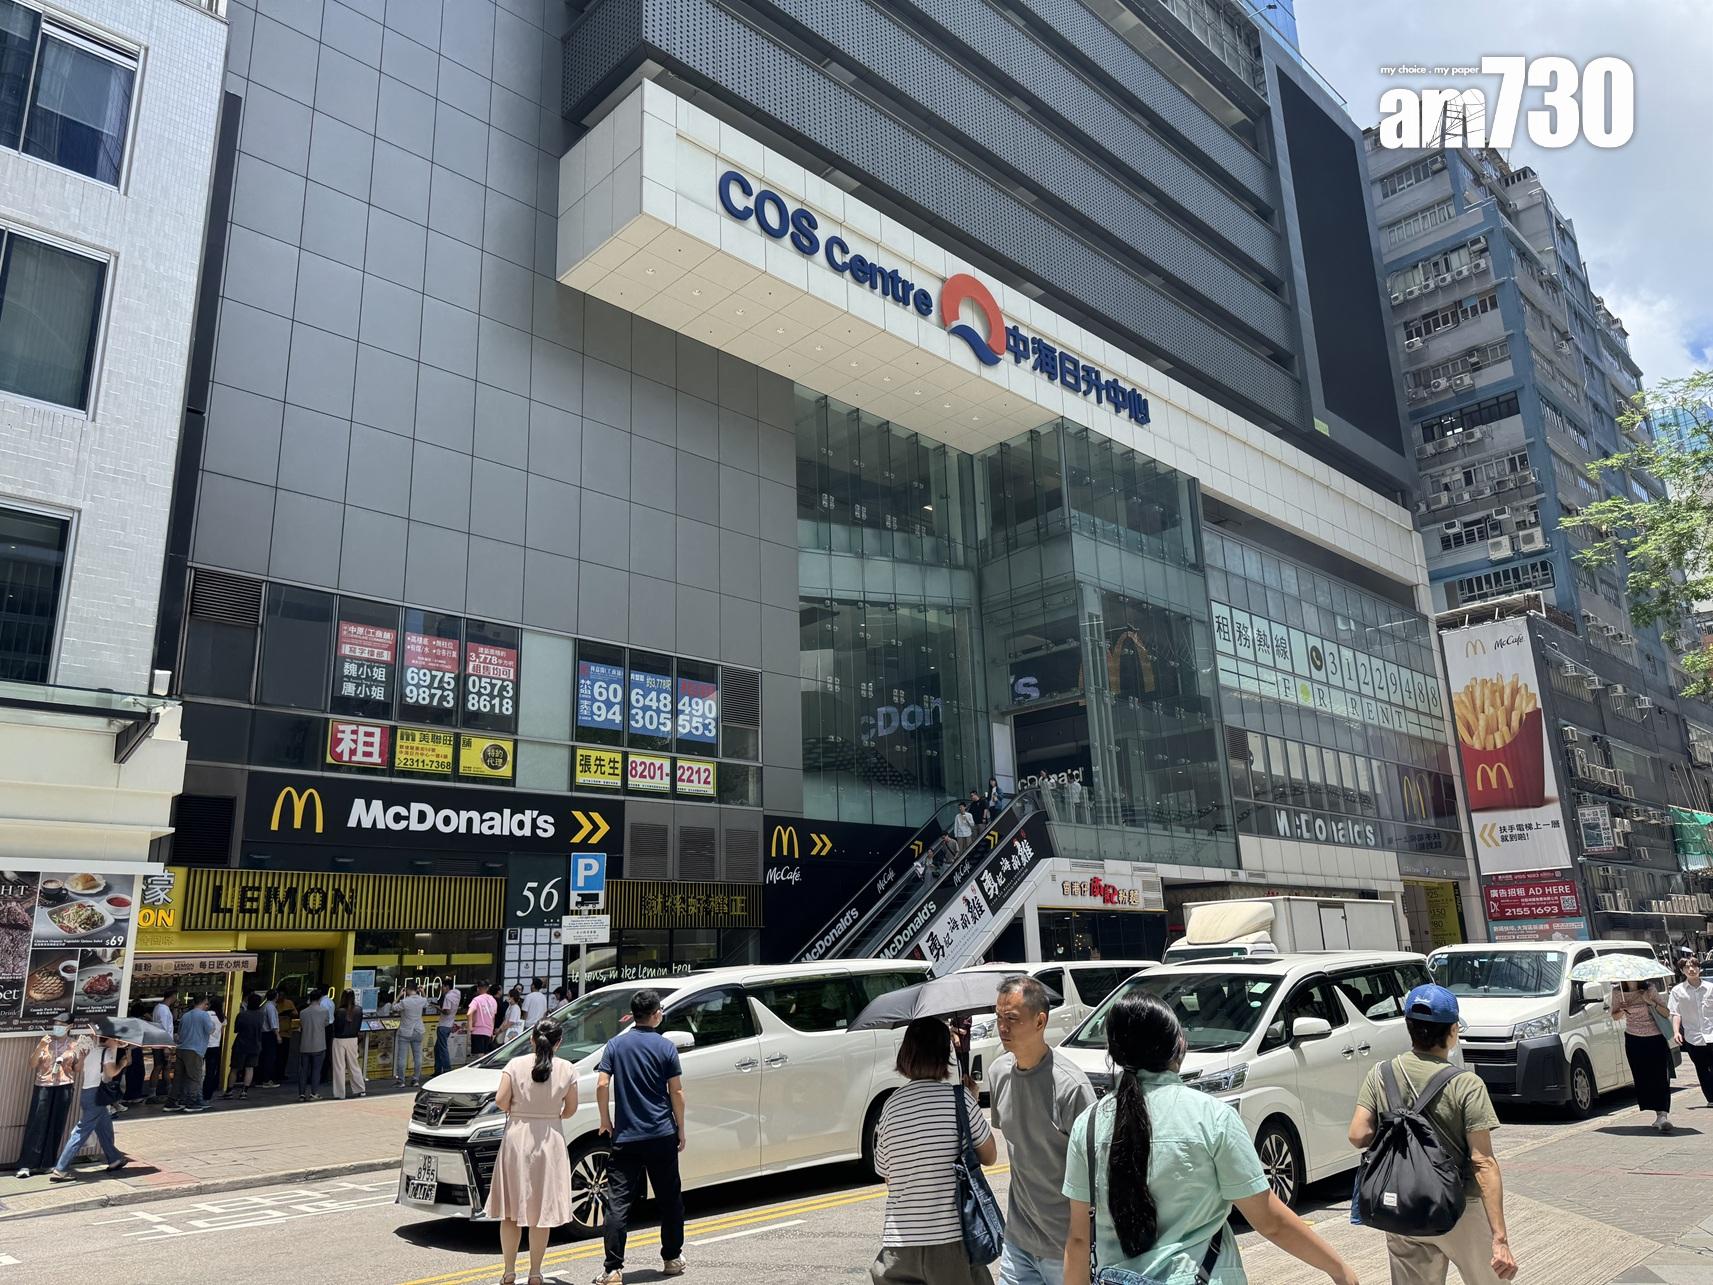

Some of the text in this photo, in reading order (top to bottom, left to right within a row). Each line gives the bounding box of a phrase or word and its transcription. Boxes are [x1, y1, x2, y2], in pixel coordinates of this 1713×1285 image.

[719, 170, 934, 317] COS Centre
[1005, 325, 1151, 426] 中海日升中心
[1215, 613, 1290, 662] 租務熱線
[343, 661, 386, 681] 魏小姐
[406, 667, 514, 698] 6975 0573
[341, 681, 385, 700] 唐小姐
[405, 685, 513, 715] 9873 8618
[593, 681, 623, 703] 60
[630, 688, 672, 712] 648
[677, 695, 717, 719] 490
[592, 701, 622, 724] 94
[630, 708, 672, 732] 305
[677, 714, 717, 737] 553
[1350, 697, 1403, 729] RENT
[335, 724, 382, 764] 租
[402, 757, 452, 770] 2311-7368
[579, 753, 621, 777] 張先生
[677, 765, 712, 786] 2212
[347, 798, 556, 839] McDonald's
[1499, 819, 1561, 834] 扶手電梯上一層
[576, 857, 600, 887] P
[766, 865, 802, 885] McCafé
[980, 838, 1035, 900] 勇記海南雞
[212, 884, 355, 915] LEMON
[516, 876, 563, 917] 56
[1489, 885, 1571, 898] 廣告招租 AD HERE
[105, 936, 124, 947] $69
[925, 895, 986, 963] 勇記海南雞
[199, 960, 249, 970] 每日匠心烘焙
